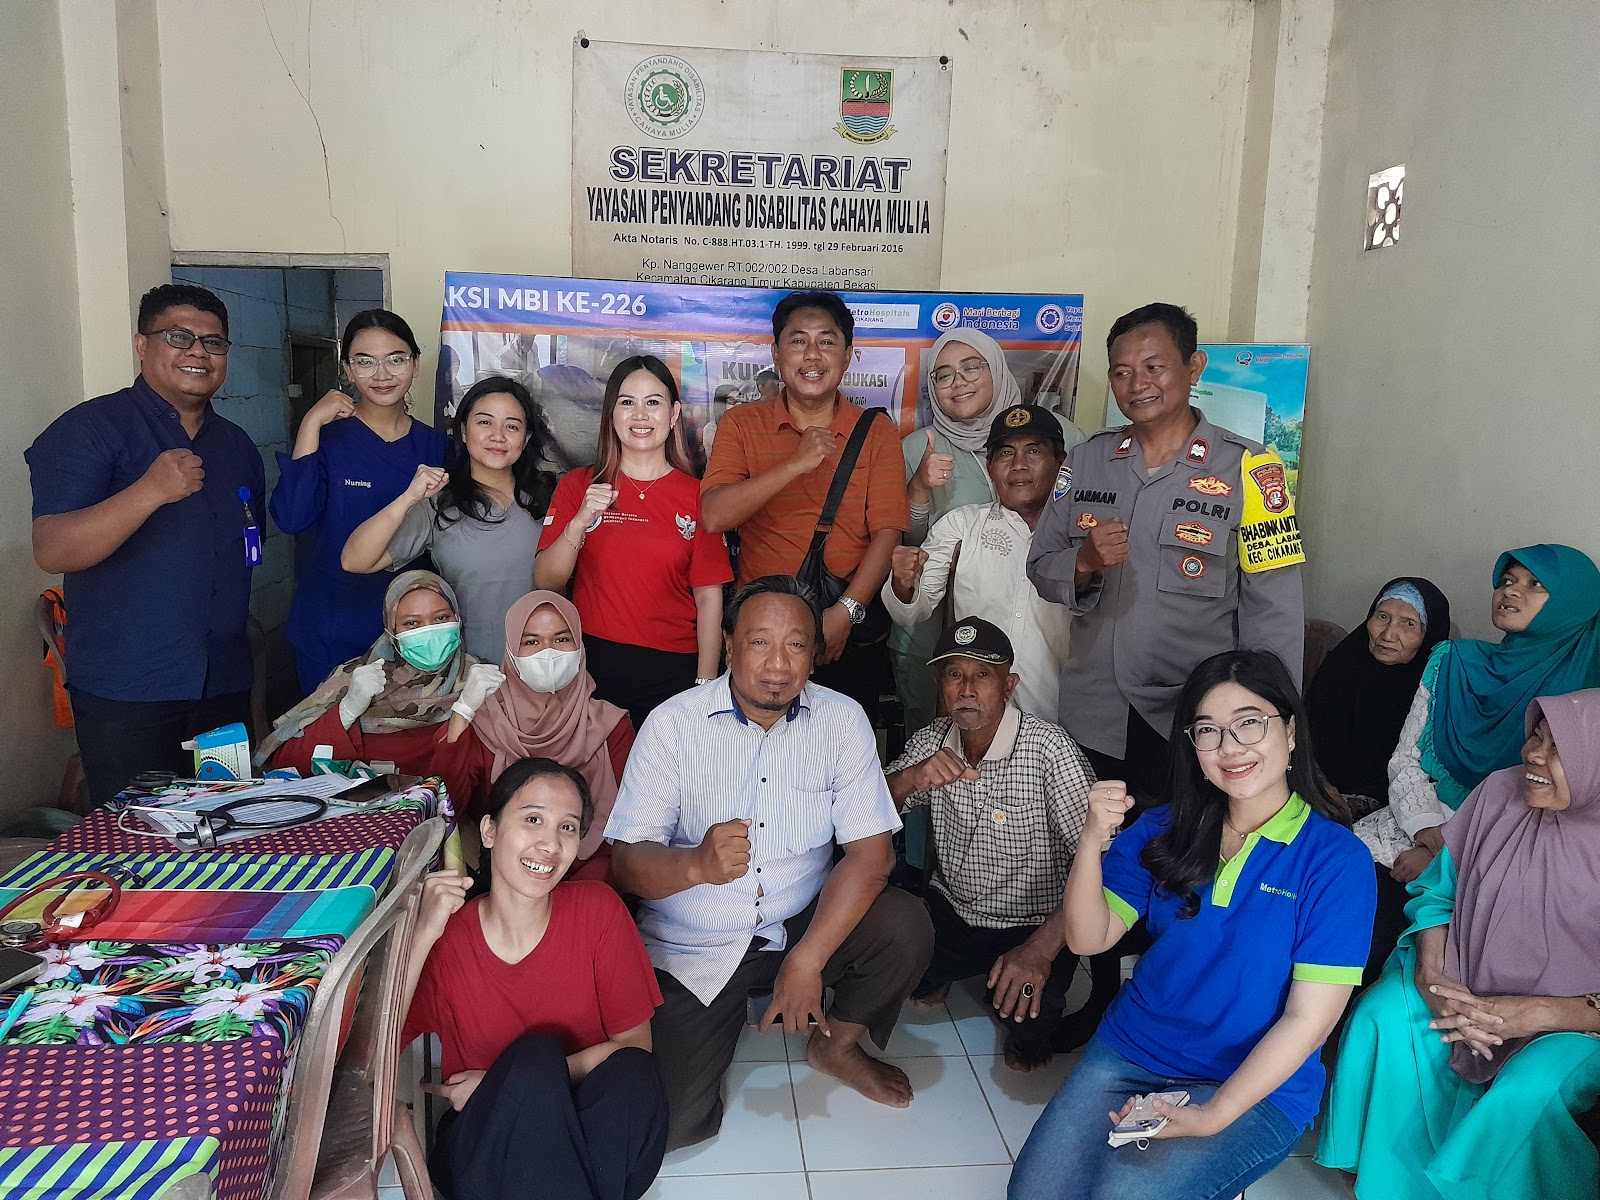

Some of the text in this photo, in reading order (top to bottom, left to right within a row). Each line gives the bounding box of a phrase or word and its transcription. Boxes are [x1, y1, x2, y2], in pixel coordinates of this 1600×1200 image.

[628, 58, 702, 112] YAYASAN PENYANDANG DISABILITAS
[635, 116, 695, 137] CAHAYA MULIA
[610, 146, 910, 193] SEKRETARIAT
[587, 187, 930, 234] YAYASAN PENYANDANG DISABILITAS CAHAYA MULIA
[613, 233, 637, 243] Akta
[640, 234, 678, 245] Notaris
[684, 236, 700, 246] No.
[813, 241, 825, 253] tgl
[827, 242, 839, 251] 29
[841, 243, 879, 252] Februari
[881, 244, 904, 253] 2016
[642, 258, 874, 277] Kp. Nanggewer RT.002/002 Desa Labansari
[636, 272, 880, 290] Kecamatan Cikarang Timur Kabupaten Bekasi
[444, 286, 647, 316] KSI MBI KE-226
[850, 308, 910, 317] etroHospitals
[963, 307, 984, 317] Mari
[986, 307, 1021, 319] Berbagi
[962, 317, 1019, 330] Indonesia
[843, 371, 888, 388] DUKASI
[344, 479, 372, 488] Nursing
[1172, 498, 1231, 520] POLRI
[1247, 540, 1274, 552] DESA.
[1247, 551, 1266, 565] KEC.
